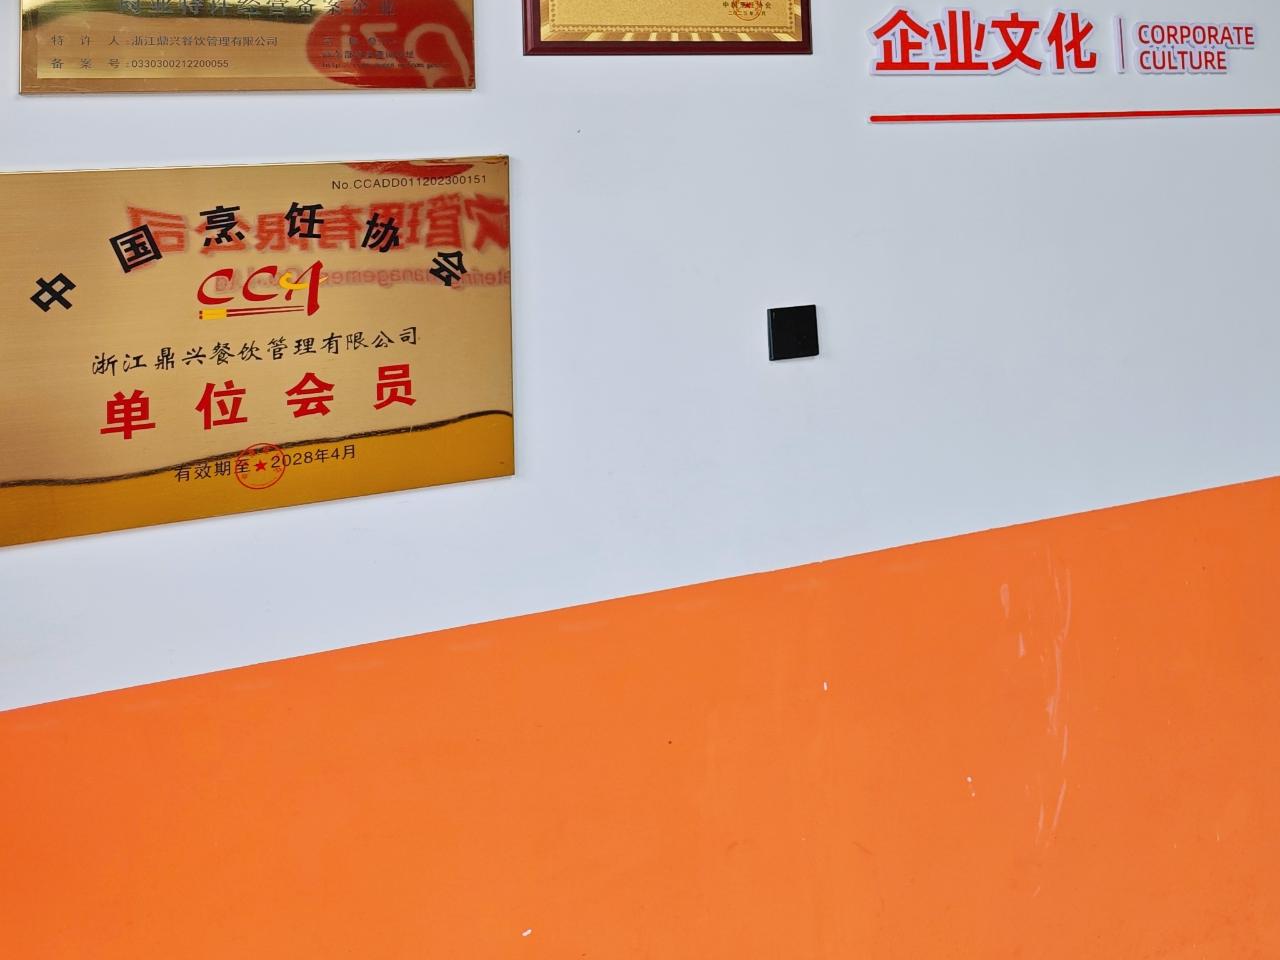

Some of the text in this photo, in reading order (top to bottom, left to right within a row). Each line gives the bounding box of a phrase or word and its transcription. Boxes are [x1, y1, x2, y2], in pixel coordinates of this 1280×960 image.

[873, 9, 1097, 71] 企业文化
[1138, 24, 1254, 46] CORPORATE
[1140, 50, 1227, 71] CULTURE
[332, 173, 488, 190] No.CCADD011202300151
[30, 201, 469, 313] 中国烹饪协会
[91, 327, 419, 376] 浙江鼎兴餐饮管理有限公司
[100, 363, 417, 441] 单位会员
